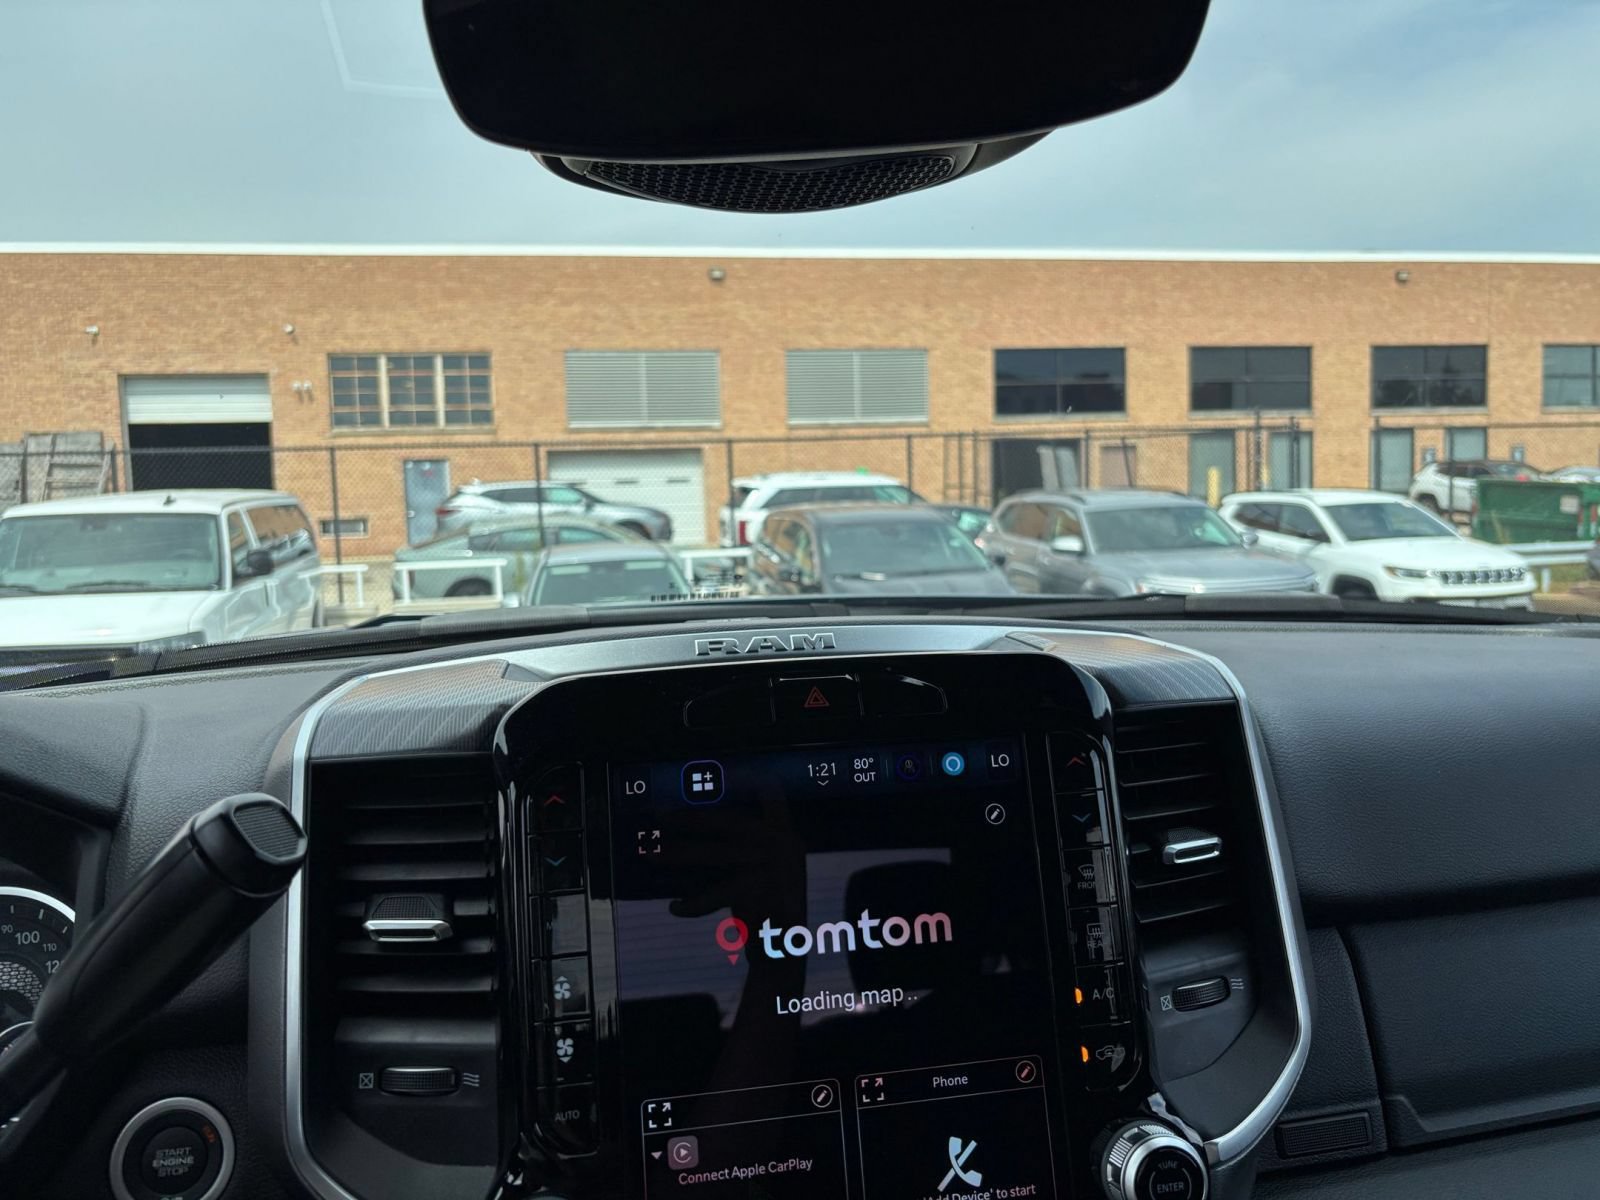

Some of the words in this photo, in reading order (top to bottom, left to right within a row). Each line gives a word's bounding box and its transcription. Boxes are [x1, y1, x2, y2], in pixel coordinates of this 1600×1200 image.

[694, 632, 837, 657] RAM
[853, 757, 874, 770] 80°
[991, 753, 1010, 768] LO
[807, 762, 837, 778] 1:21
[853, 770, 876, 783] OUT
[626, 780, 646, 795] LO
[1, 924, 13, 934] 90
[759, 908, 953, 959] tomtom
[15, 931, 41, 945] 100
[43, 943, 58, 952] 110
[1092, 987, 1115, 1000] A/C
[776, 991, 855, 1015] Loading
[932, 1074, 969, 1088] Phone
[554, 1109, 580, 1121] AUTO
[155, 1147, 192, 1158] START
[152, 1156, 194, 1168] ENGINE
[1157, 1160, 1179, 1170] TUNE
[157, 1166, 189, 1177] STOP
[678, 1167, 730, 1186] Connect
[731, 1163, 767, 1181] Apple
[768, 1157, 813, 1175] CarPlay
[996, 1188, 1008, 1199] to
[1010, 1184, 1036, 1198] start
[1157, 1181, 1185, 1194] ENTER
